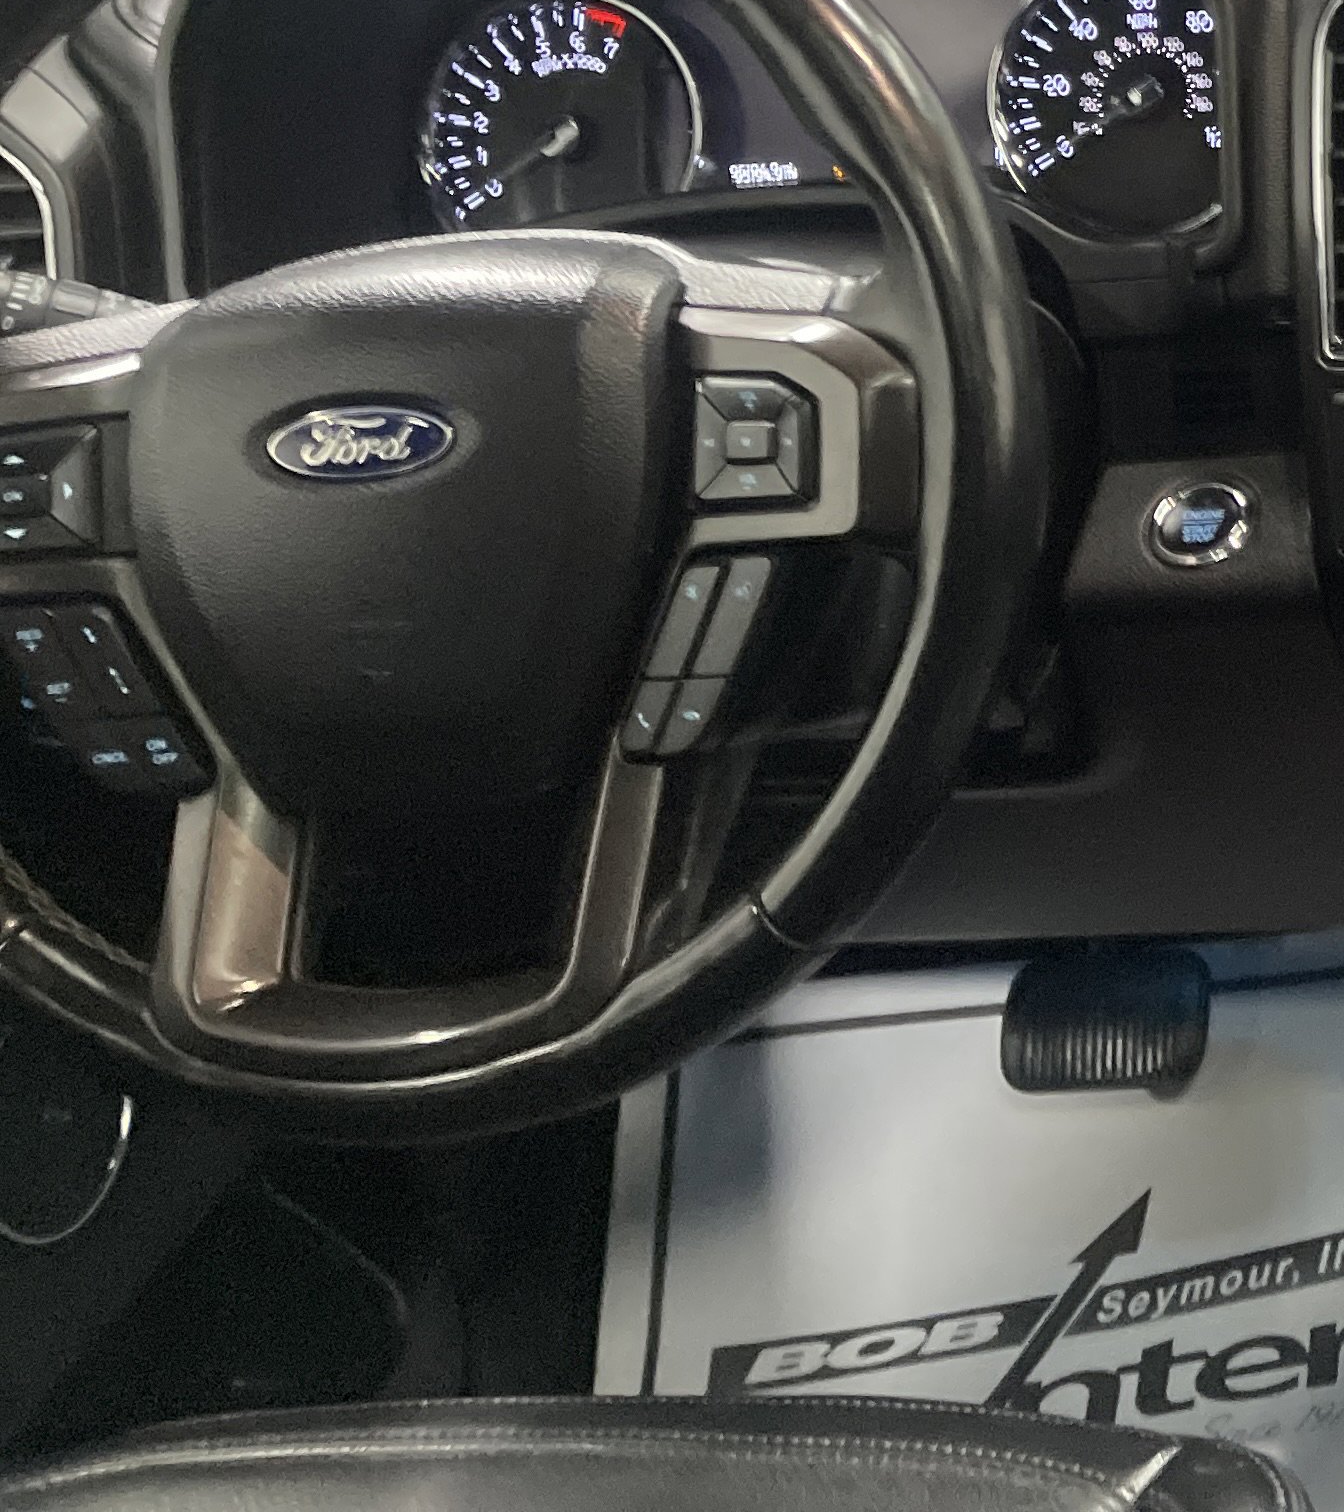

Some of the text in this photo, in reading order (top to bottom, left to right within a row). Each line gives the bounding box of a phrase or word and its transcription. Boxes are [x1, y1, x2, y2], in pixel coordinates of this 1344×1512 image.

[302, 414, 422, 467] Ford
[1097, 1254, 1301, 1325] Seymour,
[745, 1311, 1004, 1385] BOB
